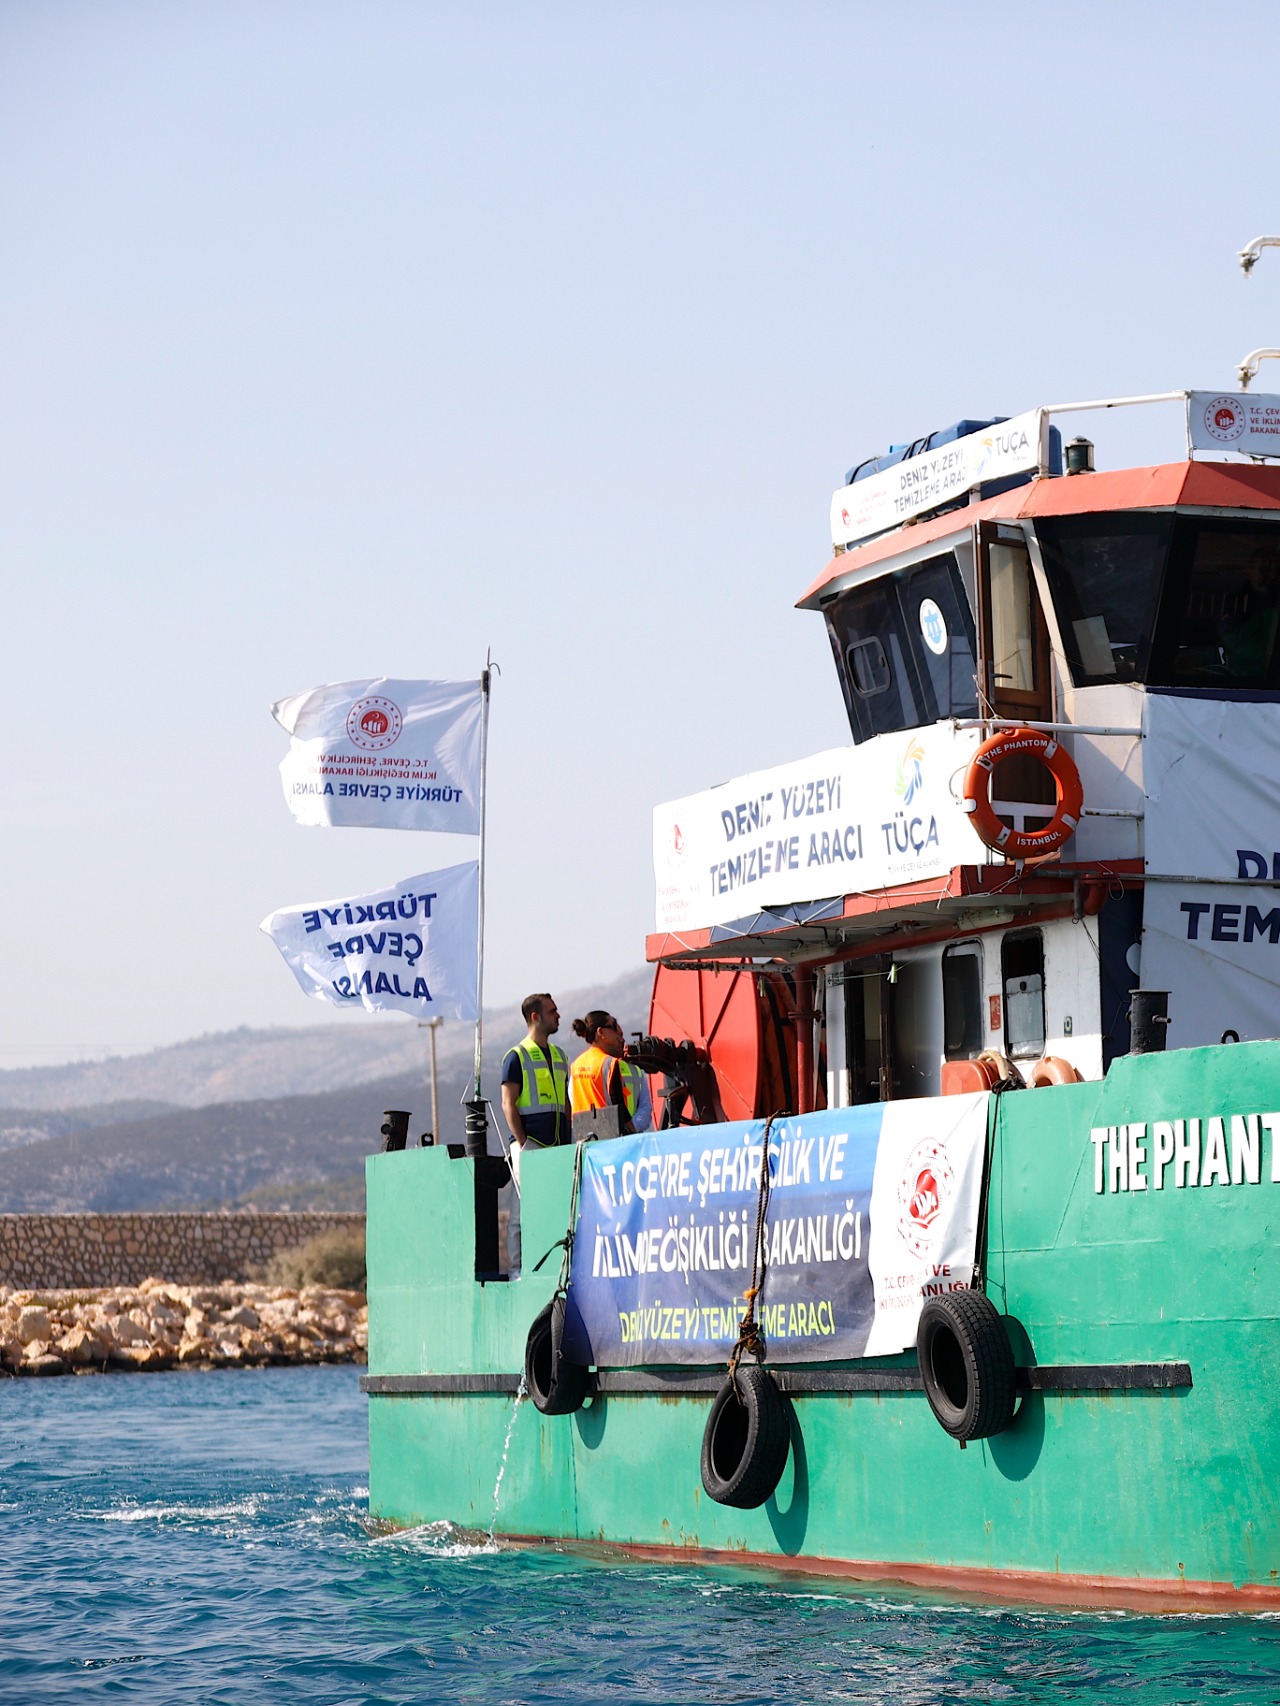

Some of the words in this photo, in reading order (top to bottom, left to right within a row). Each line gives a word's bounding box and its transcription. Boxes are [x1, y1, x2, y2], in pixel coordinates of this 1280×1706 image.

[984, 747, 1003, 760] THE
[1004, 739, 1048, 752] PHANTOM
[807, 824, 863, 867] ARACI
[881, 811, 939, 857] TÜÇA
[1017, 831, 1062, 846] İSTANBUL
[819, 1133, 849, 1182] VE
[1090, 1123, 1148, 1194] THE
[932, 1264, 951, 1277] VE
[788, 1301, 835, 1337] ARACI
